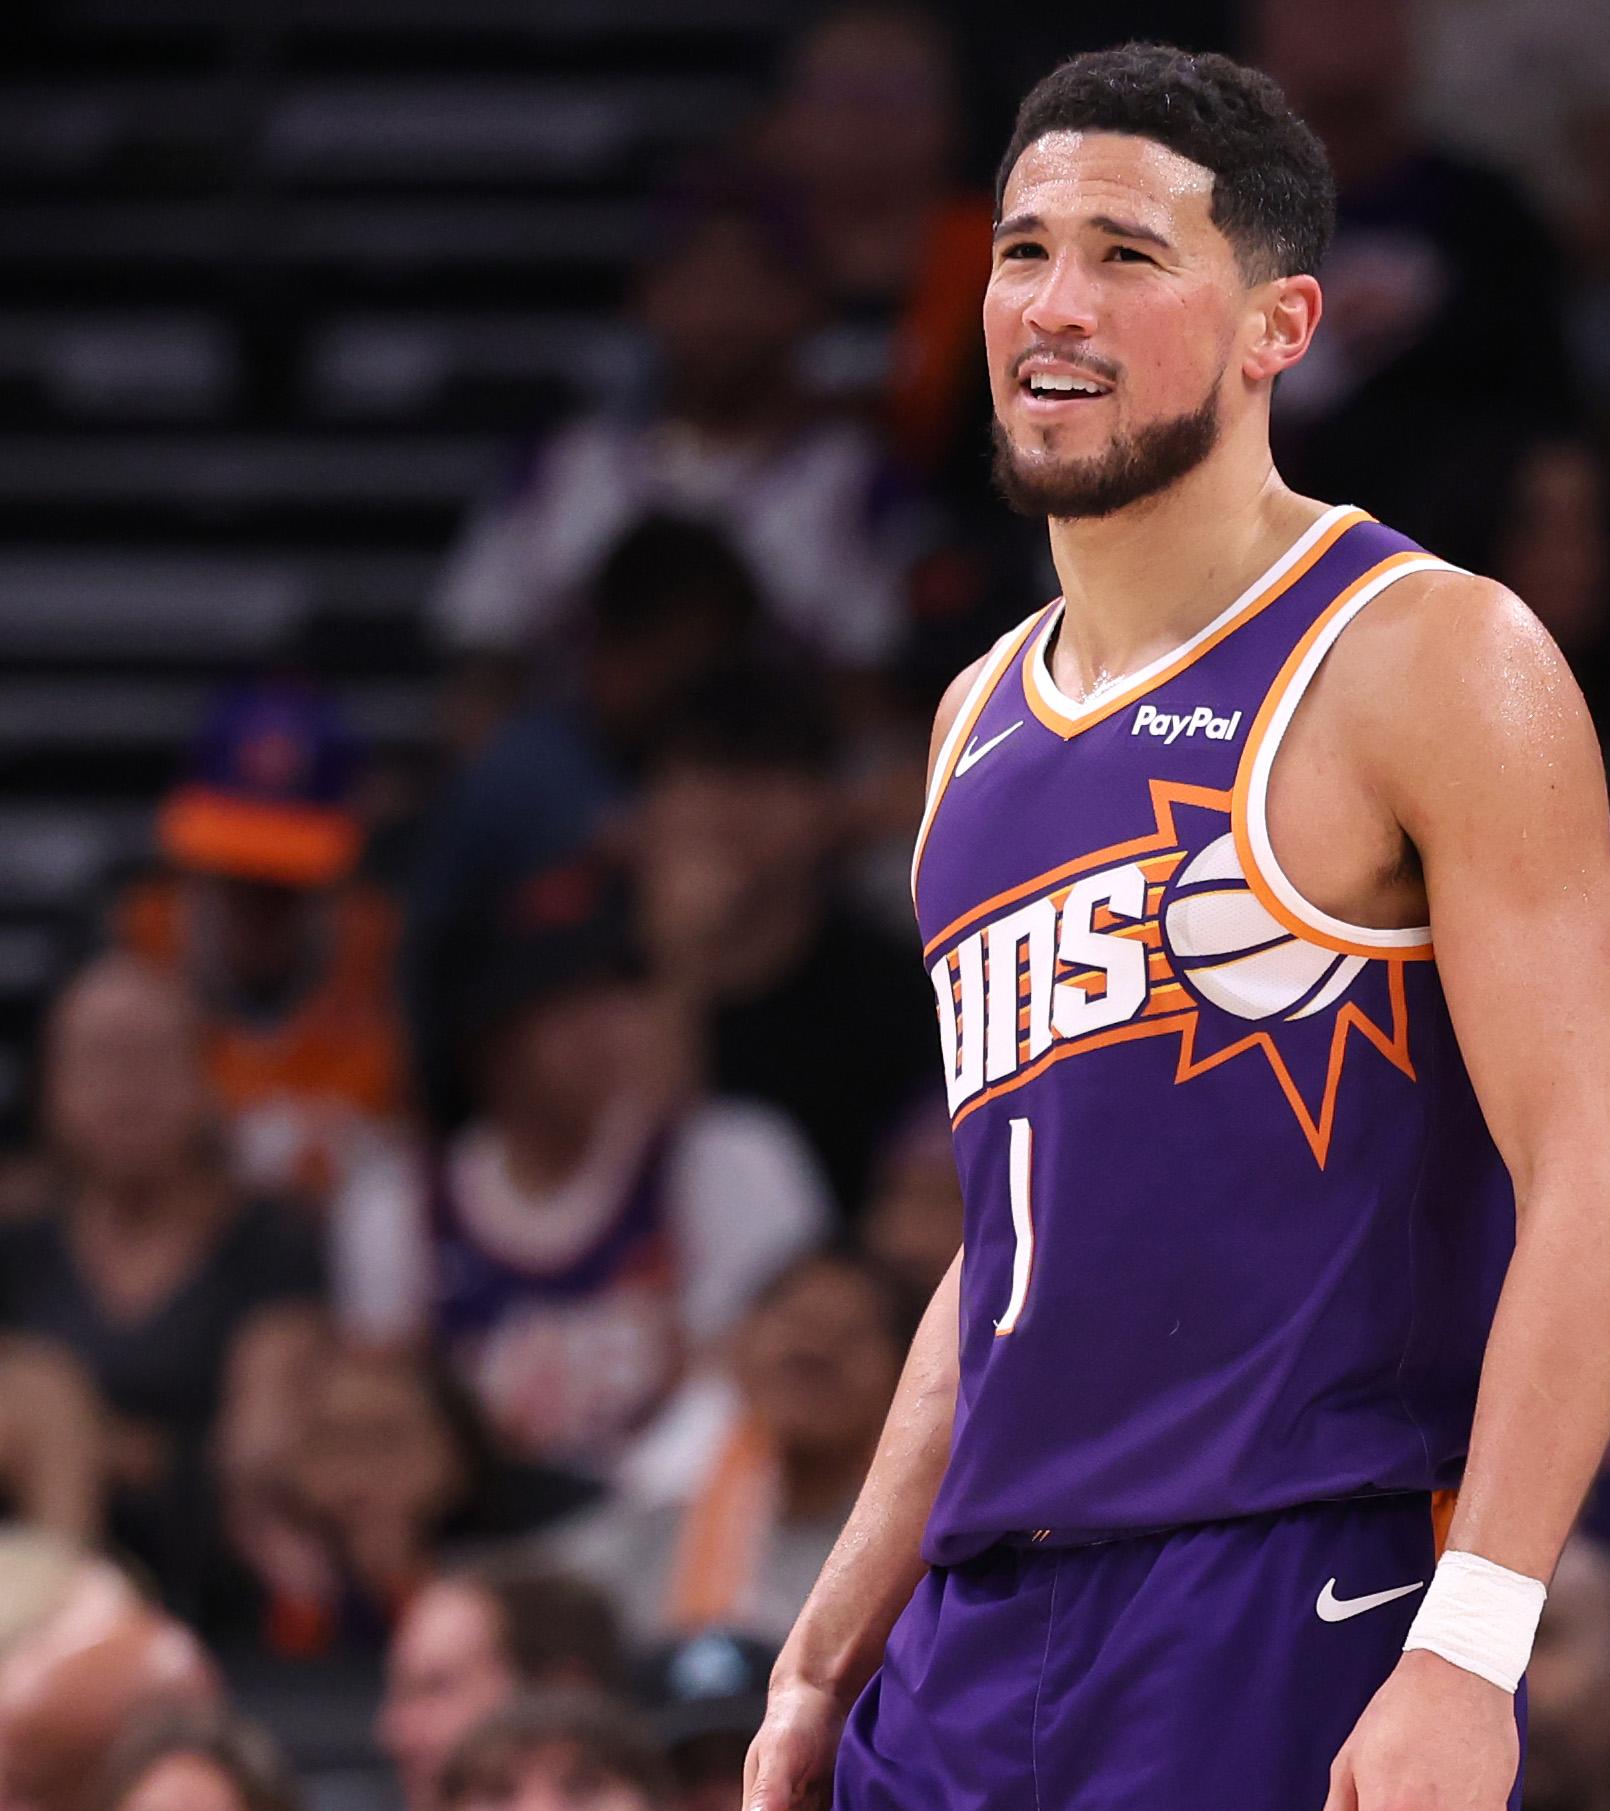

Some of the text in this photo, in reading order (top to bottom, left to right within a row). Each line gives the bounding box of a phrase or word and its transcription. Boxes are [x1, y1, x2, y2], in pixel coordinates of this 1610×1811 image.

[1131, 705, 1242, 745] PayPal
[930, 863, 1147, 1119] UNS
[993, 1118, 1034, 1336] 1
